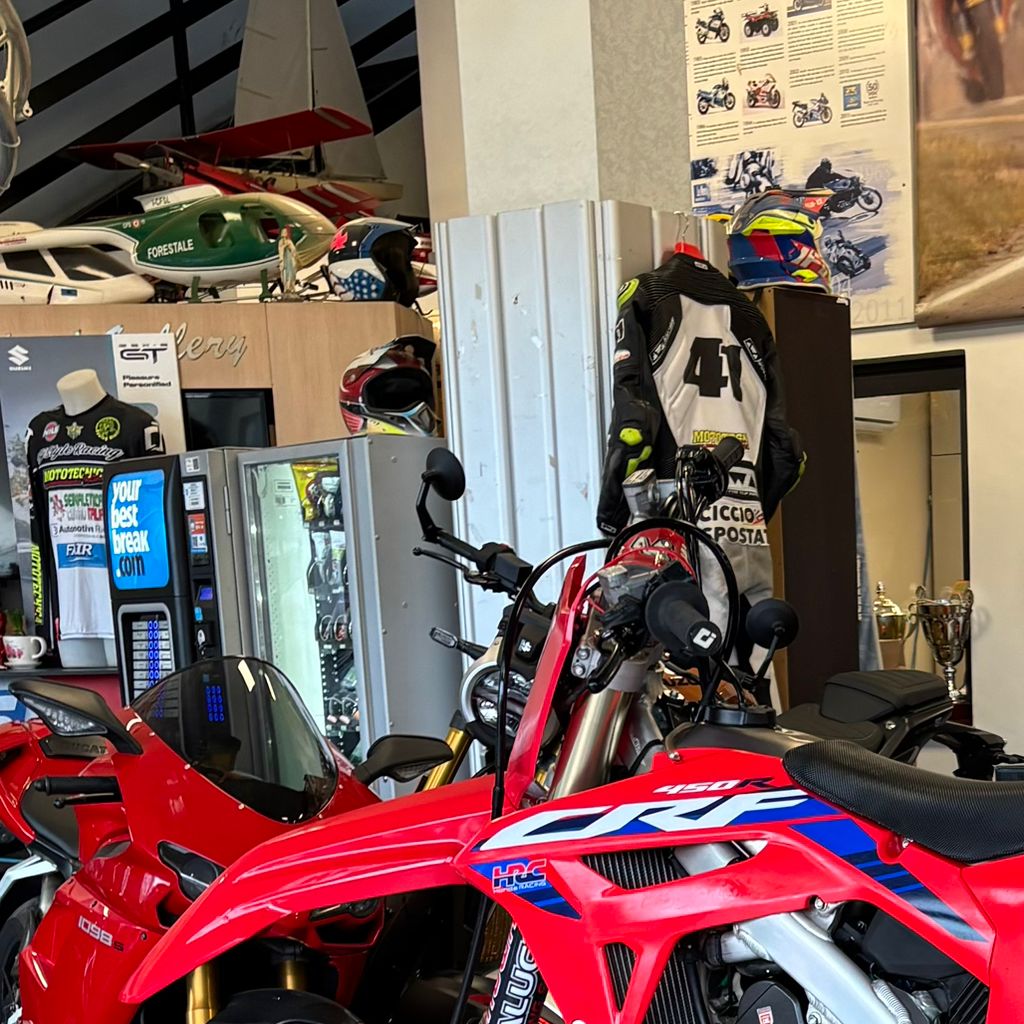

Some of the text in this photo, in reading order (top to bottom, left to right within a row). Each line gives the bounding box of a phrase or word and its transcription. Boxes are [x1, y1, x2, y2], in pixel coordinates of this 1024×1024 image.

[147, 239, 194, 259] FORESTALE
[681, 336, 743, 402] 41
[111, 479, 143, 504] your
[110, 504, 139, 528] best
[700, 504, 755, 522] CICCIO
[111, 530, 150, 555] break
[116, 555, 146, 578] .com
[652, 776, 776, 795] 450R
[479, 789, 811, 850] CRF
[492, 858, 547, 889] HRC
[78, 914, 112, 947] 1098
